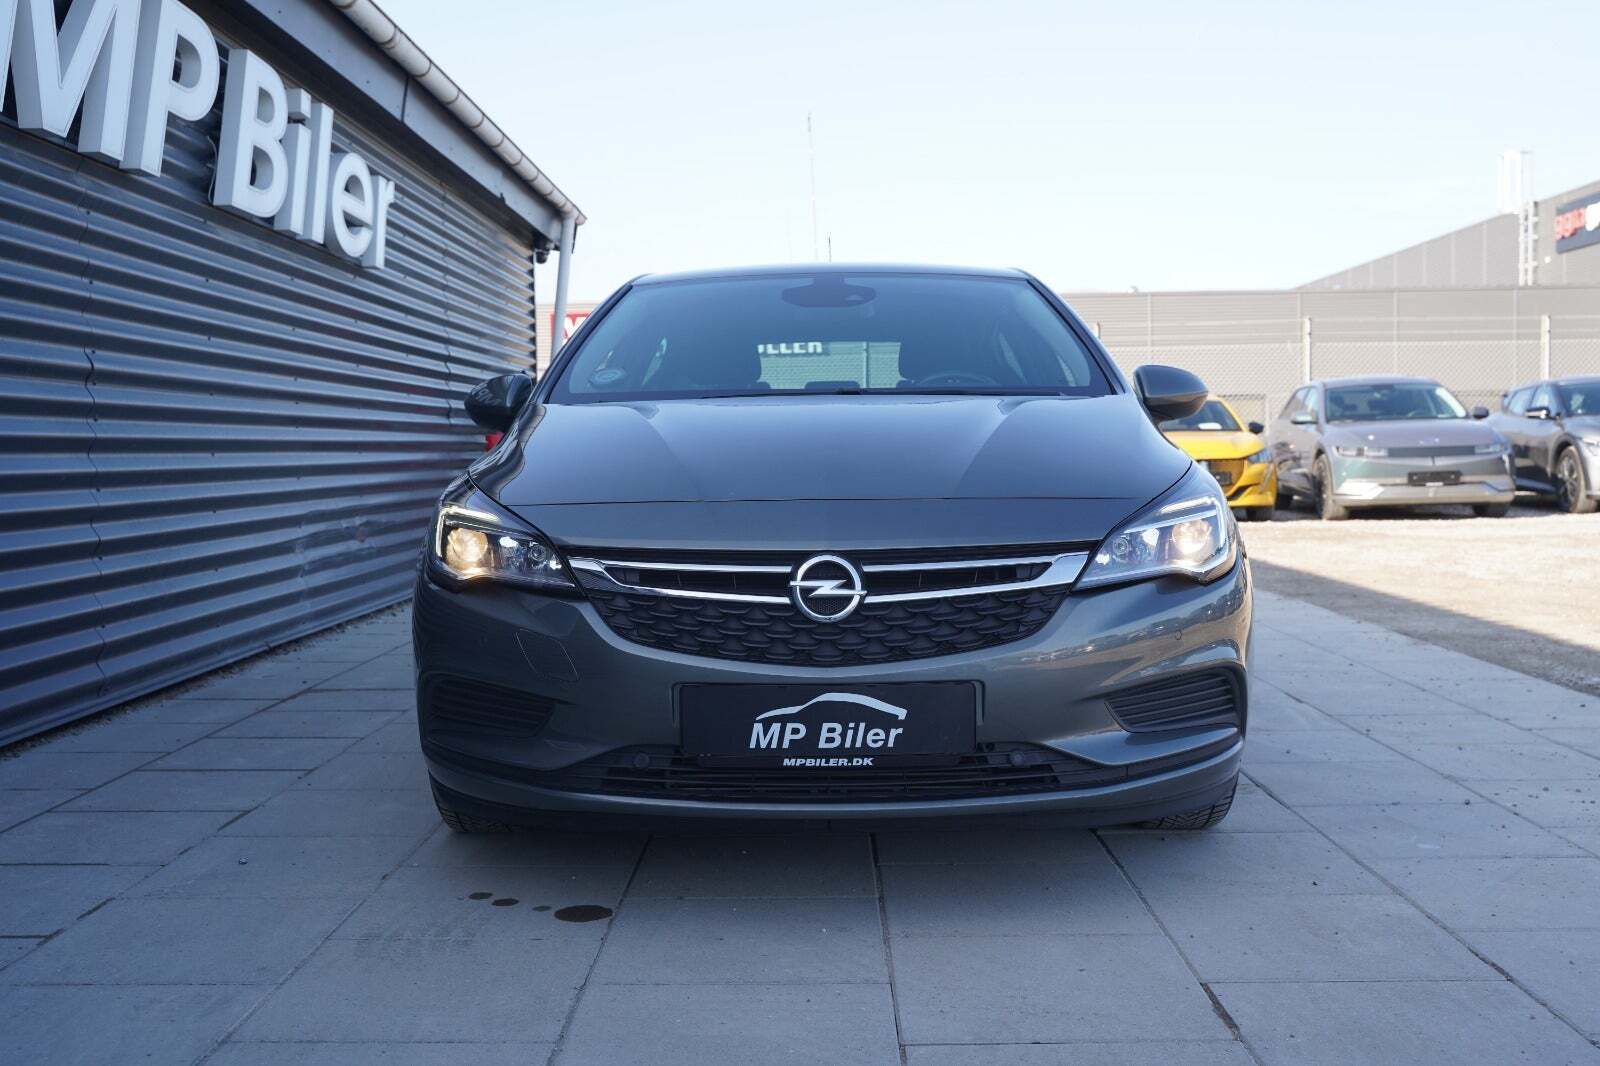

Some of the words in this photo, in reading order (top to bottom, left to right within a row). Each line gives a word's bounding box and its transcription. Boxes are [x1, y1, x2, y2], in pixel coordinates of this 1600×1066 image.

[0, 0, 220, 177] MP
[213, 48, 396, 269] Biler
[749, 722, 807, 749] MP
[818, 722, 904, 749] Biler
[783, 757, 874, 767] MPBILER.DK
